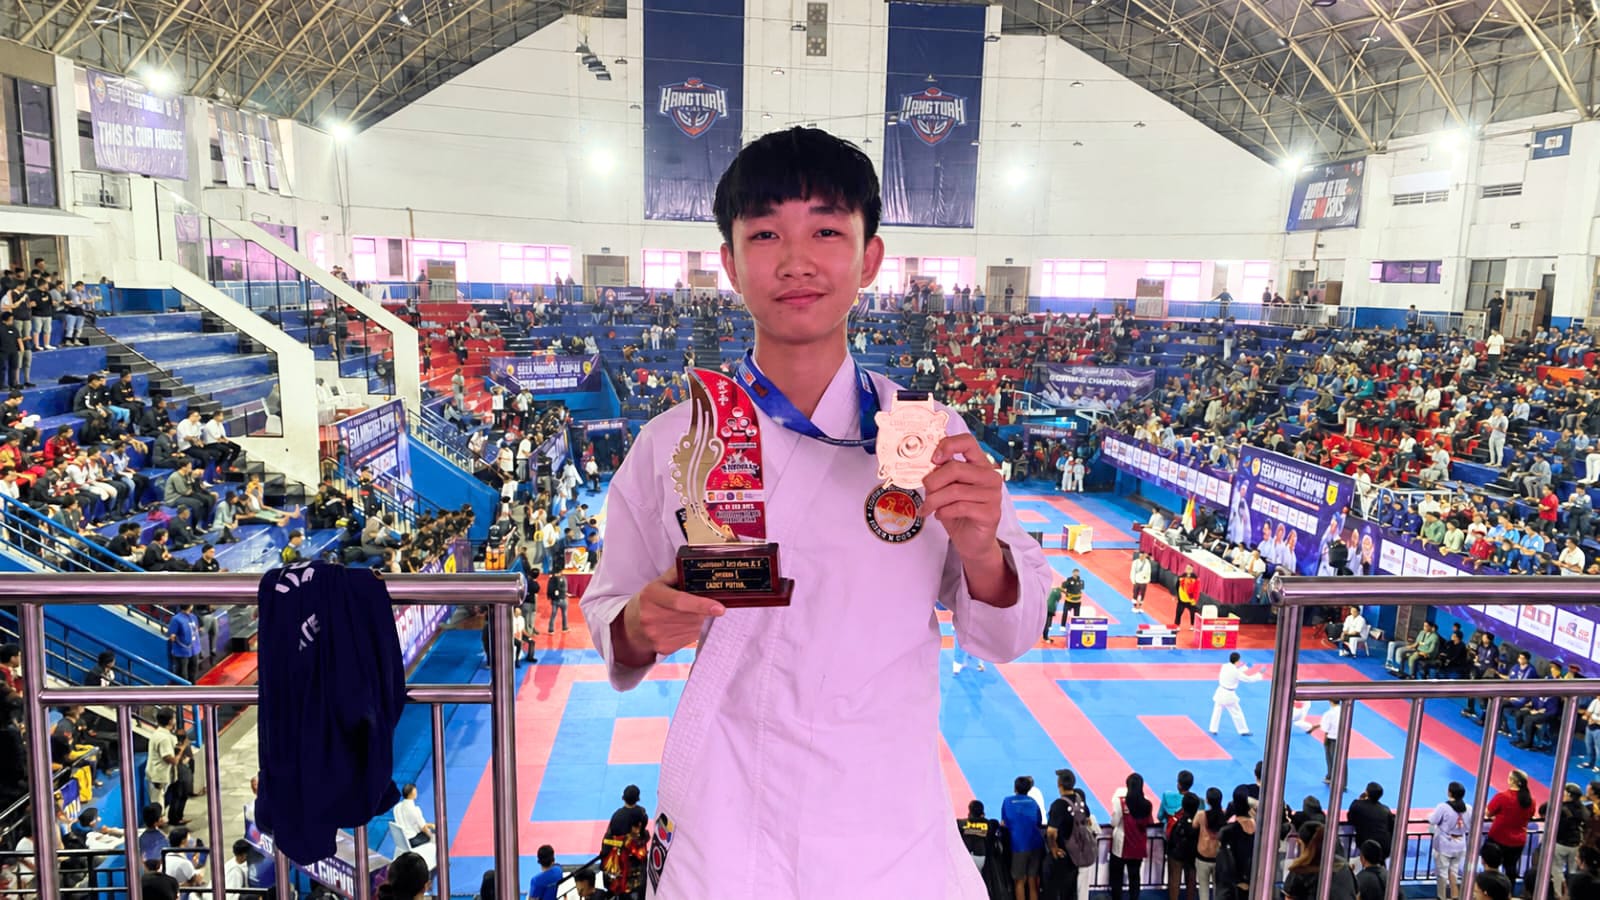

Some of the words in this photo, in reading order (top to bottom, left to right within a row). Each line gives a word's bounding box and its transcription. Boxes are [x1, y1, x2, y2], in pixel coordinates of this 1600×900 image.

[98, 121, 122, 146] THIS
[123, 124, 134, 146] IS
[135, 126, 153, 148] OUR
[154, 128, 182, 150] HOUSE
